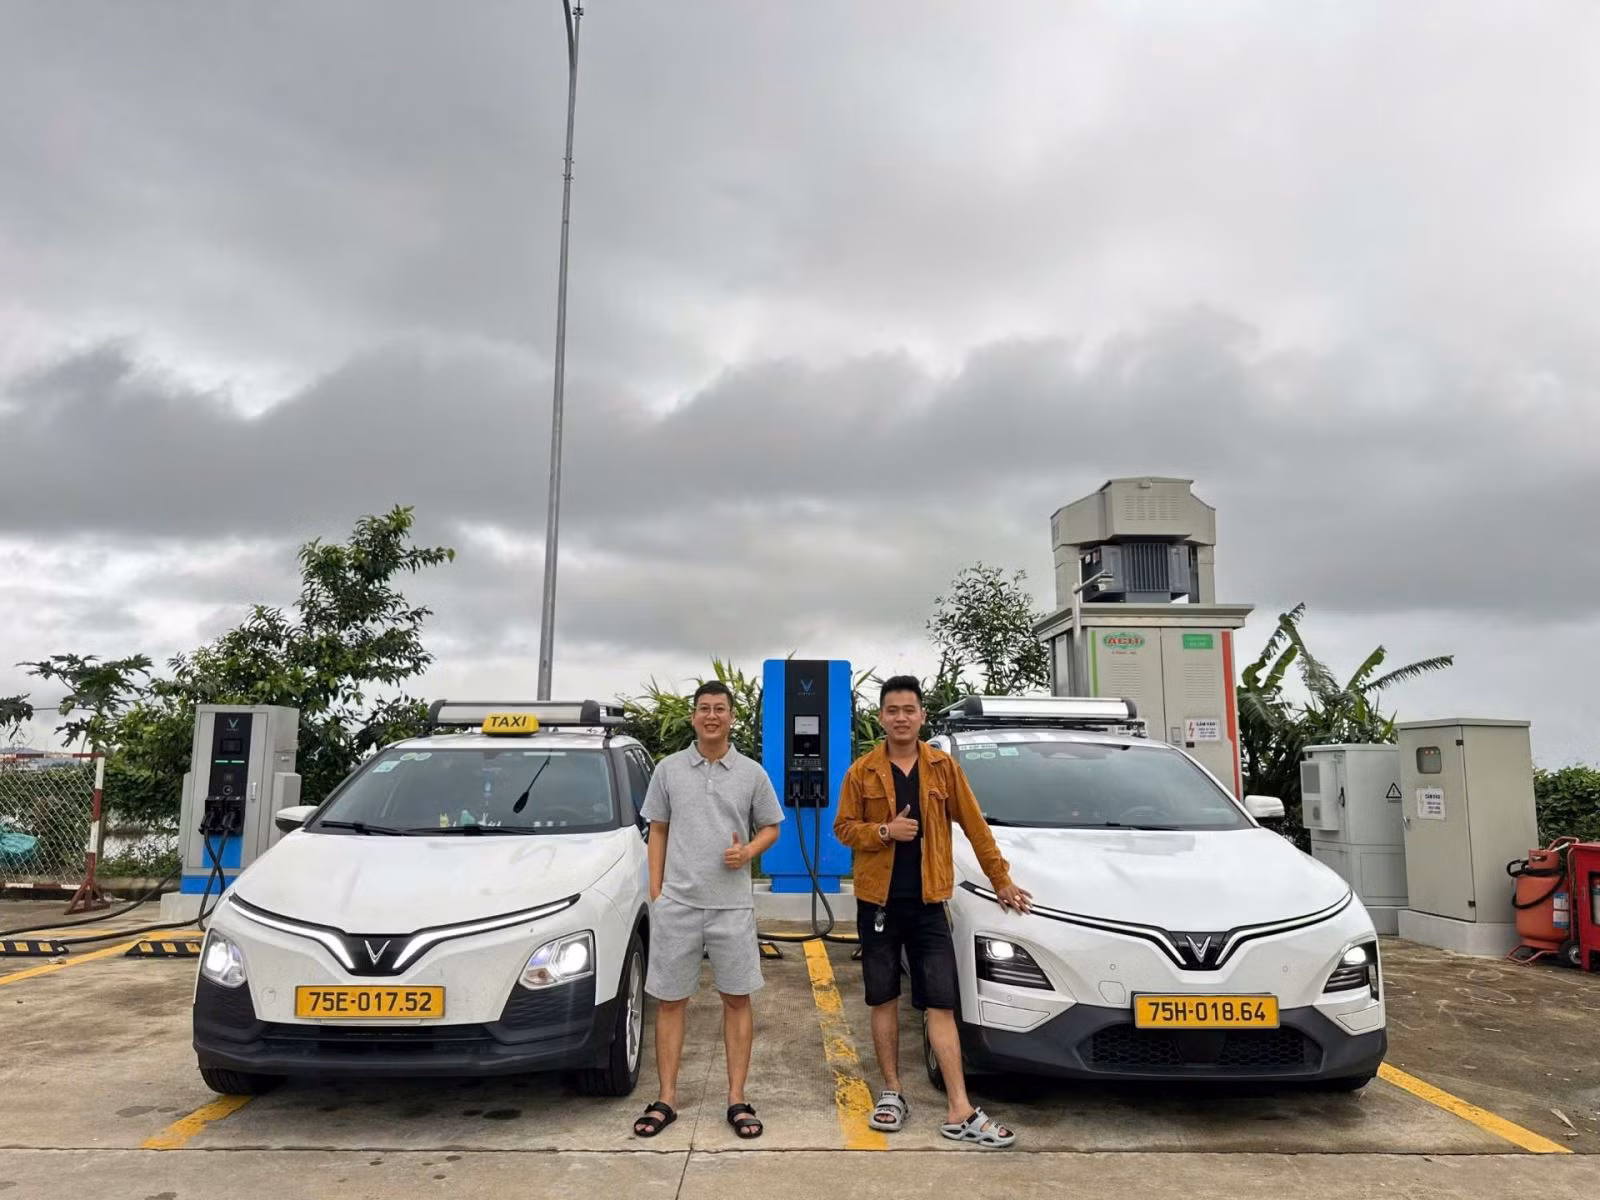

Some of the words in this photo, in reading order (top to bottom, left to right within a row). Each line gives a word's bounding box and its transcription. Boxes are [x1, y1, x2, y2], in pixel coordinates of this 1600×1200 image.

[490, 716, 527, 727] TAXI
[308, 991, 432, 1012] 75E-017.52
[1148, 1001, 1266, 1022] 75H-018.64
